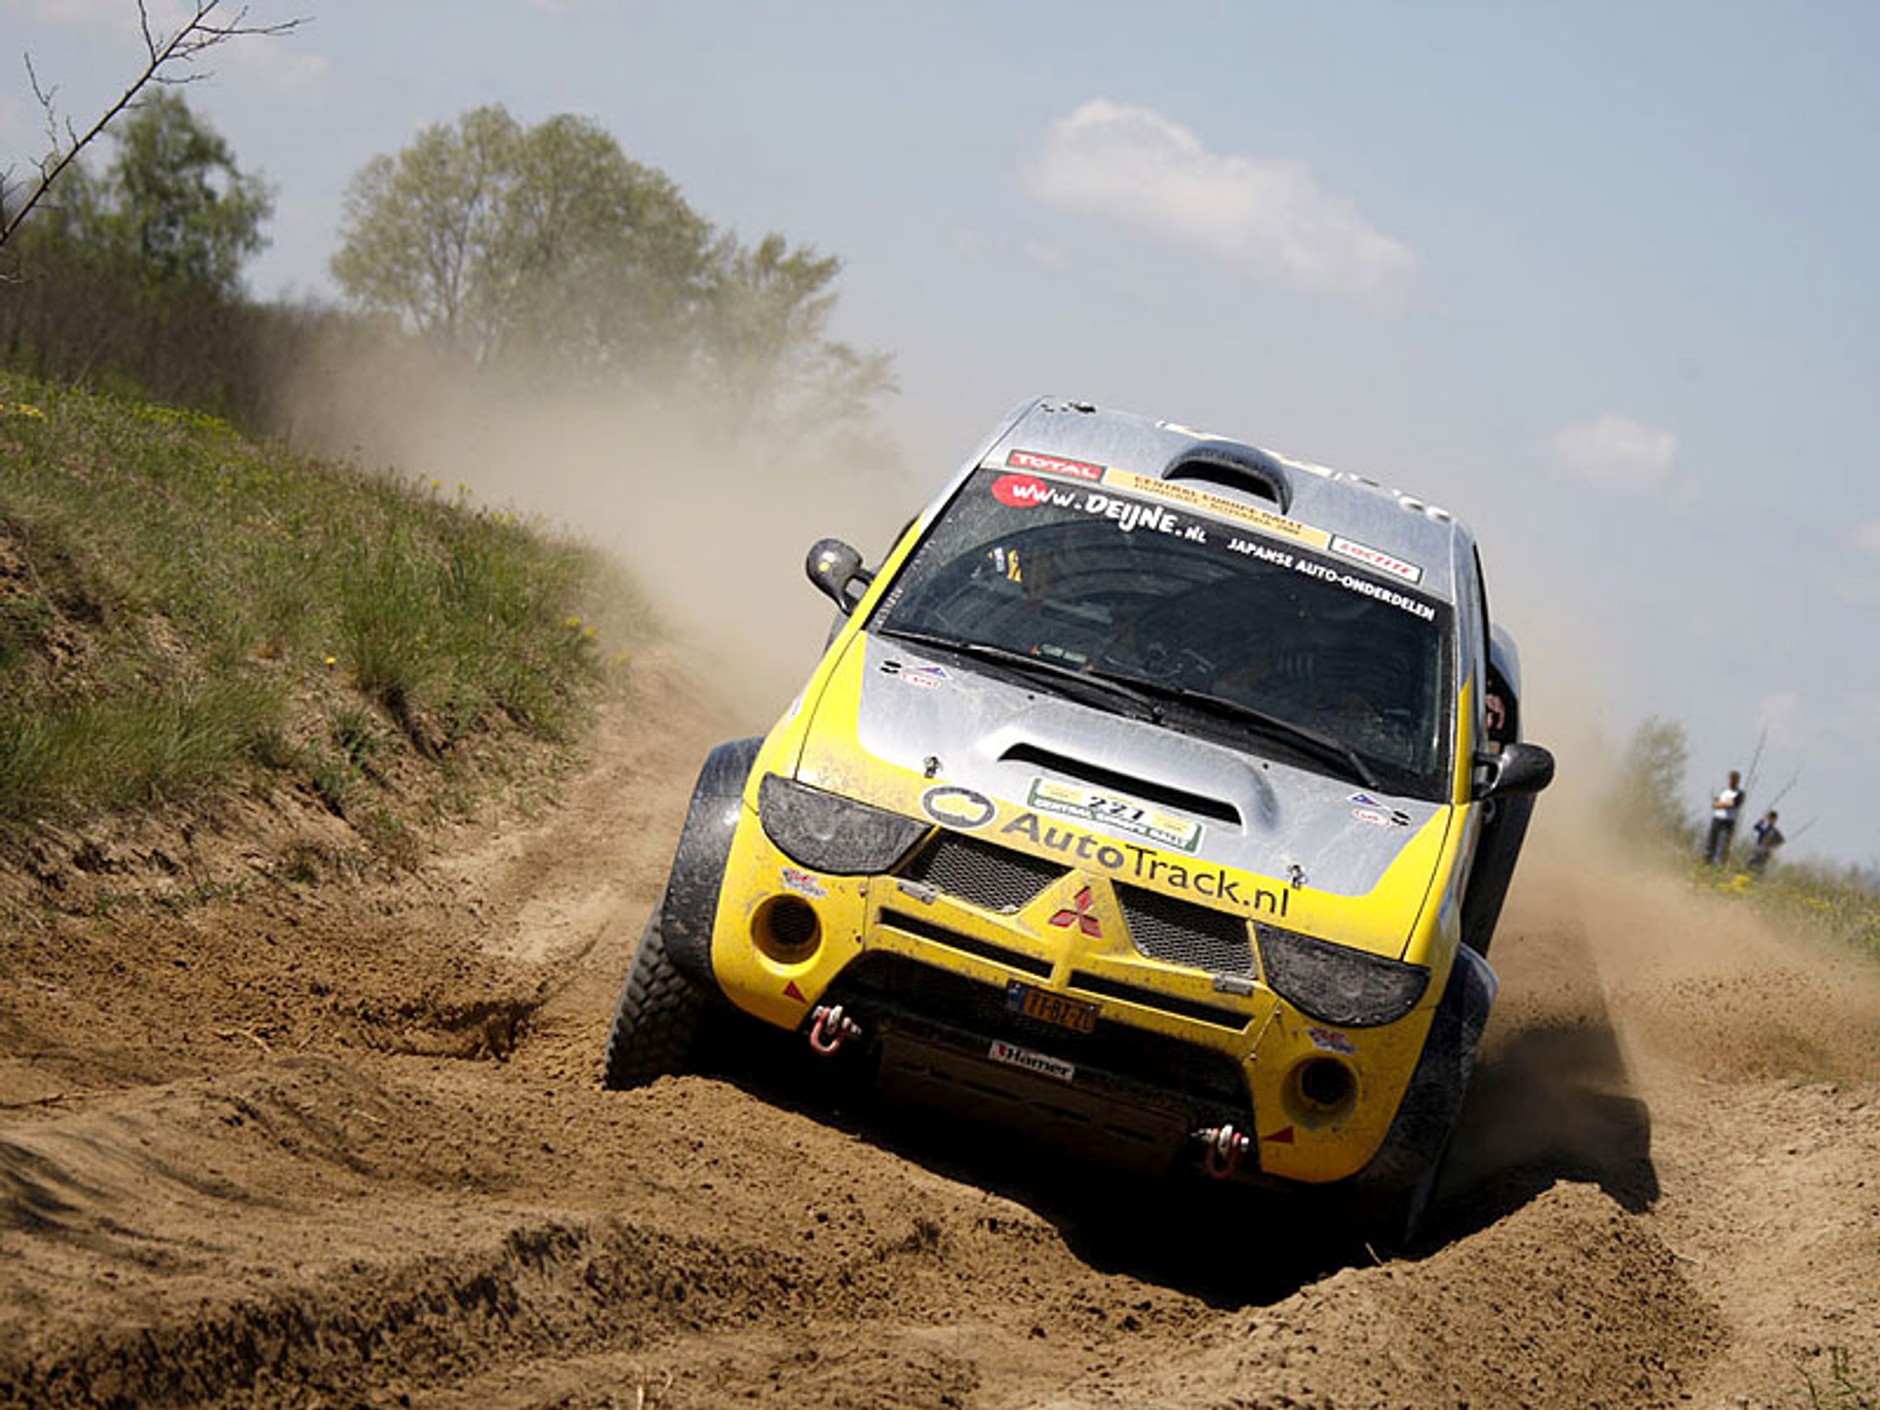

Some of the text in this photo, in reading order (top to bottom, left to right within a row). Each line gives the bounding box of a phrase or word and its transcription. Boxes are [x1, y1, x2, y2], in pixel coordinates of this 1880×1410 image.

[1014, 453, 1098, 480] TOTAL
[1339, 541, 1414, 576] LOCTITE
[1226, 537, 1436, 622] JAPANSE AUTO-ONDERDELEN
[1088, 795, 1146, 821] 227
[1000, 812, 1290, 918] AutoTrack.nl
